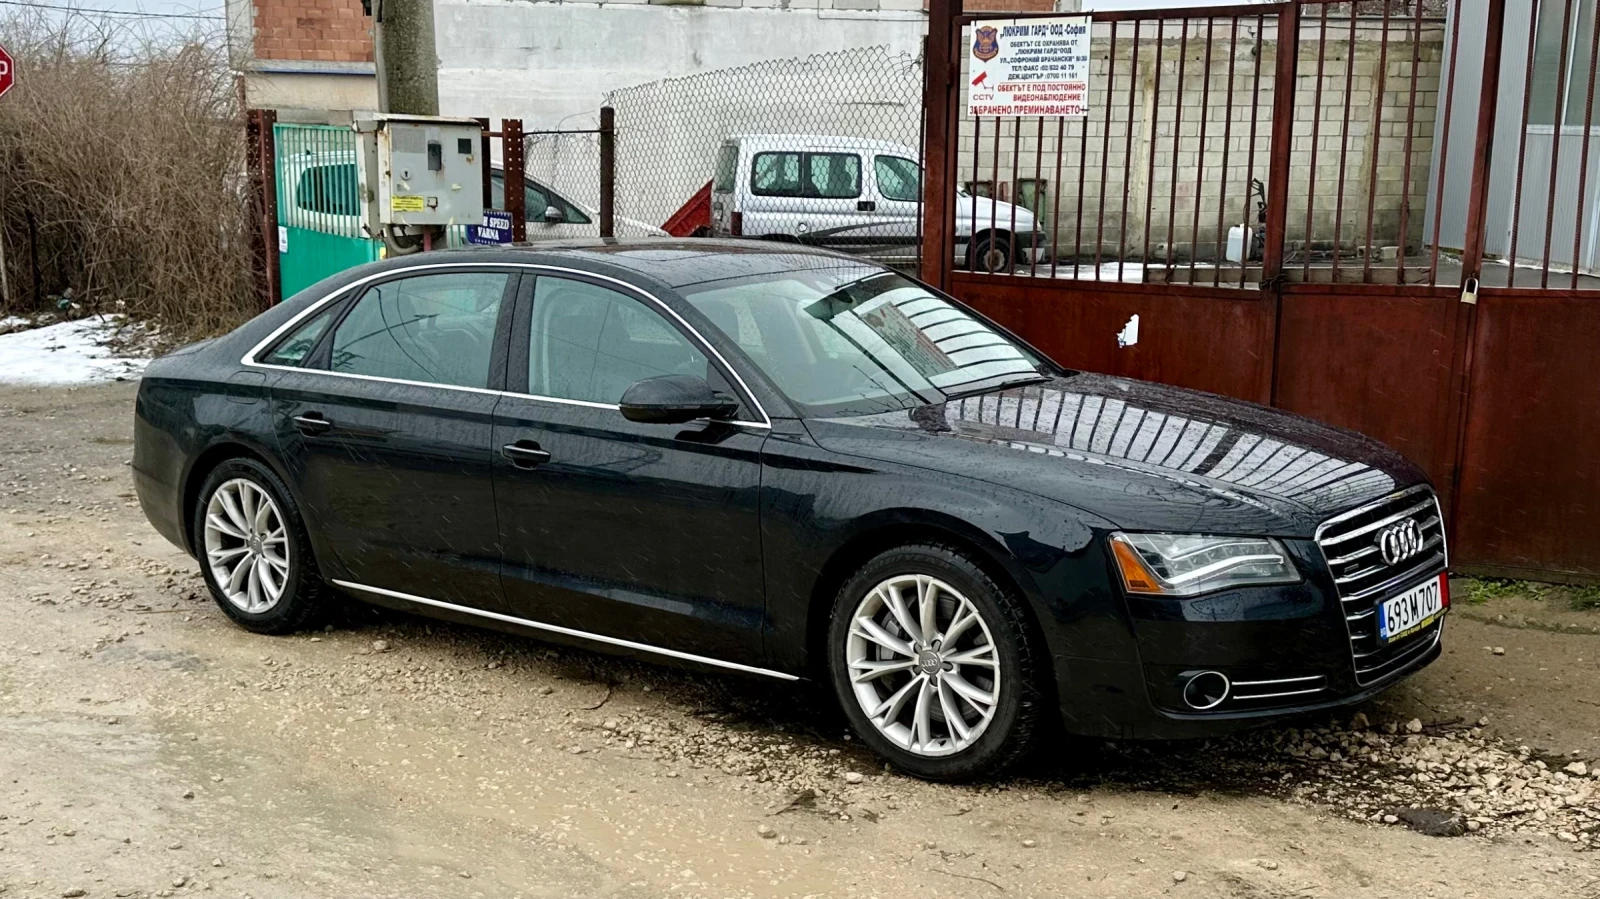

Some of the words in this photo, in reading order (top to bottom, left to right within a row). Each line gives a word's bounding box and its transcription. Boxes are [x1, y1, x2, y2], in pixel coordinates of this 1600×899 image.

[1050, 24, 1063, 36] ООД
[998, 84, 1026, 92] ОБЕКТЪТ
[1032, 84, 1046, 92] ПОД
[1047, 83, 1086, 92] ПОСТОЯННО
[1013, 94, 1081, 102] ВИДЕОНАБЛЮДЕНИЕ
[970, 105, 1012, 115] ЗАБРАНЕНО
[1014, 104, 1080, 114] ПРЕМИНАВАНЕТО
[489, 217, 509, 230] SPEED
[477, 226, 500, 240] VARNA
